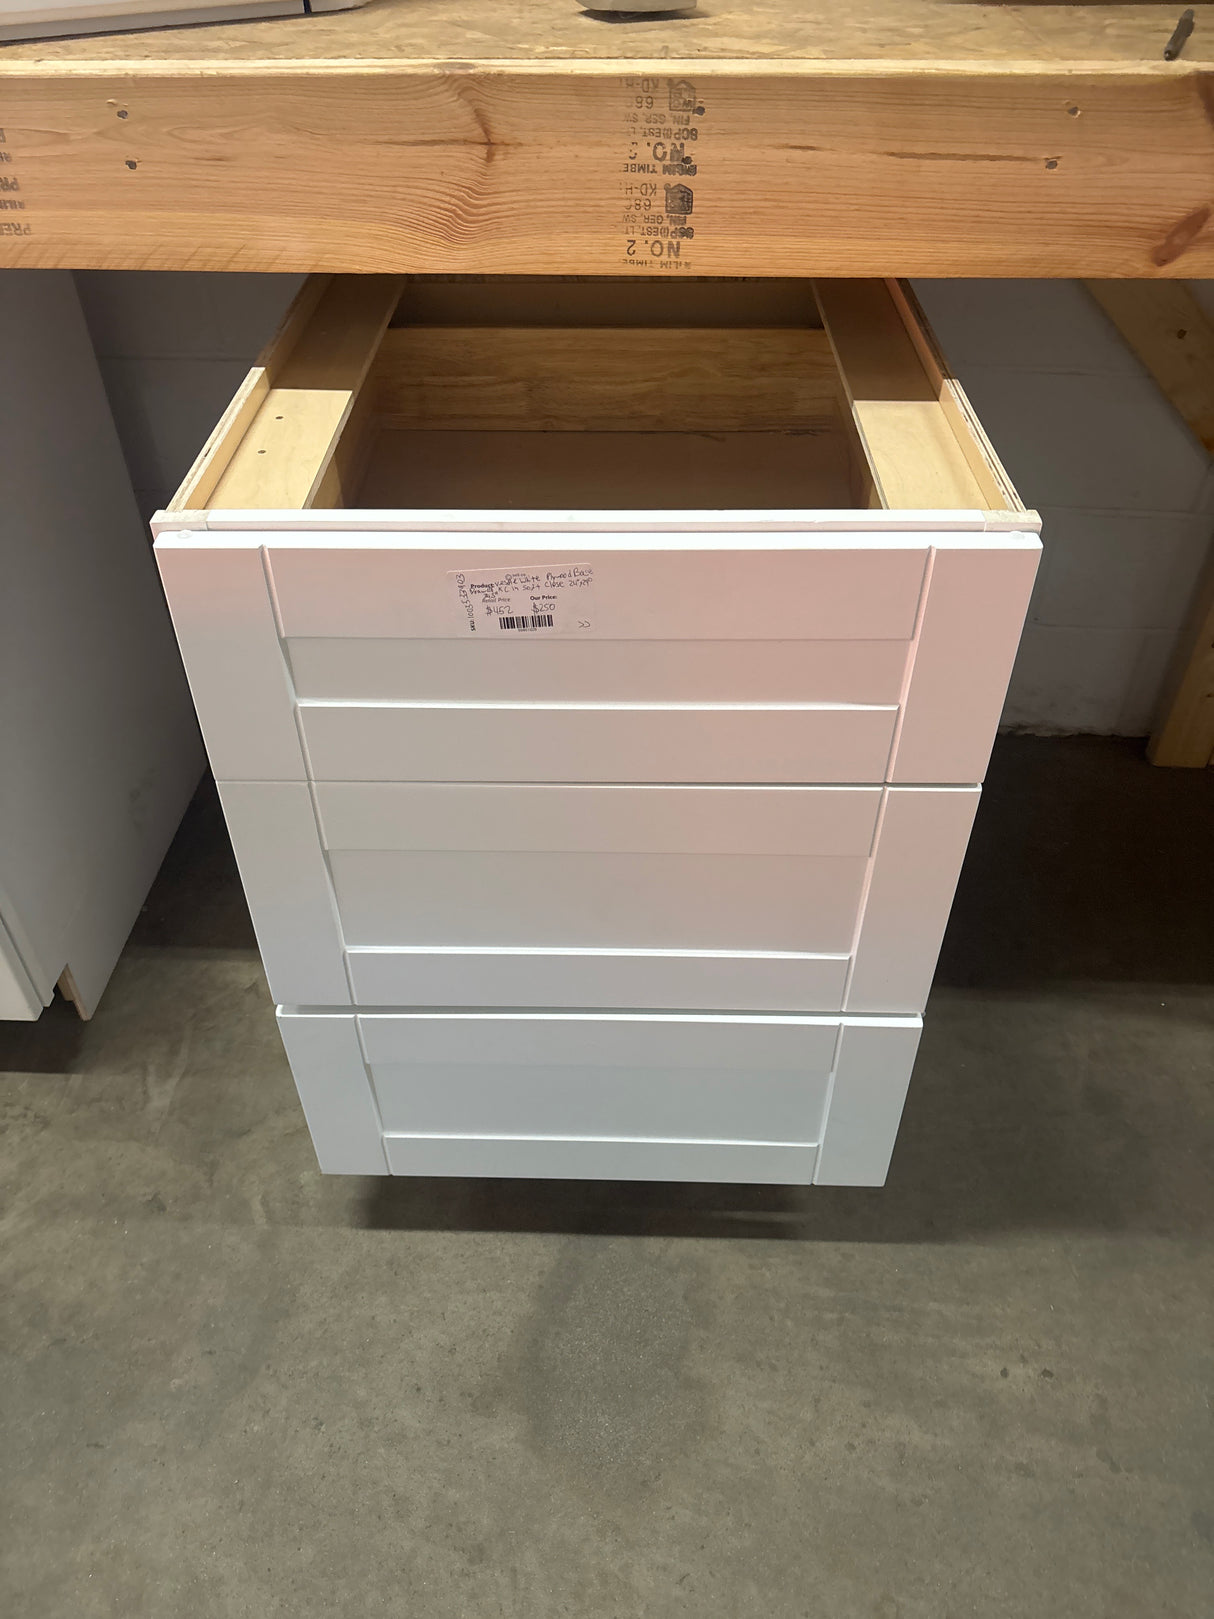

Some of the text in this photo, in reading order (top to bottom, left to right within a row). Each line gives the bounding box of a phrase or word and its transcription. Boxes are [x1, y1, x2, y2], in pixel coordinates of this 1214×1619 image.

[626, 239, 681, 259] NO. 2
[485, 605, 514, 617] $452
[531, 602, 556, 616] $250
